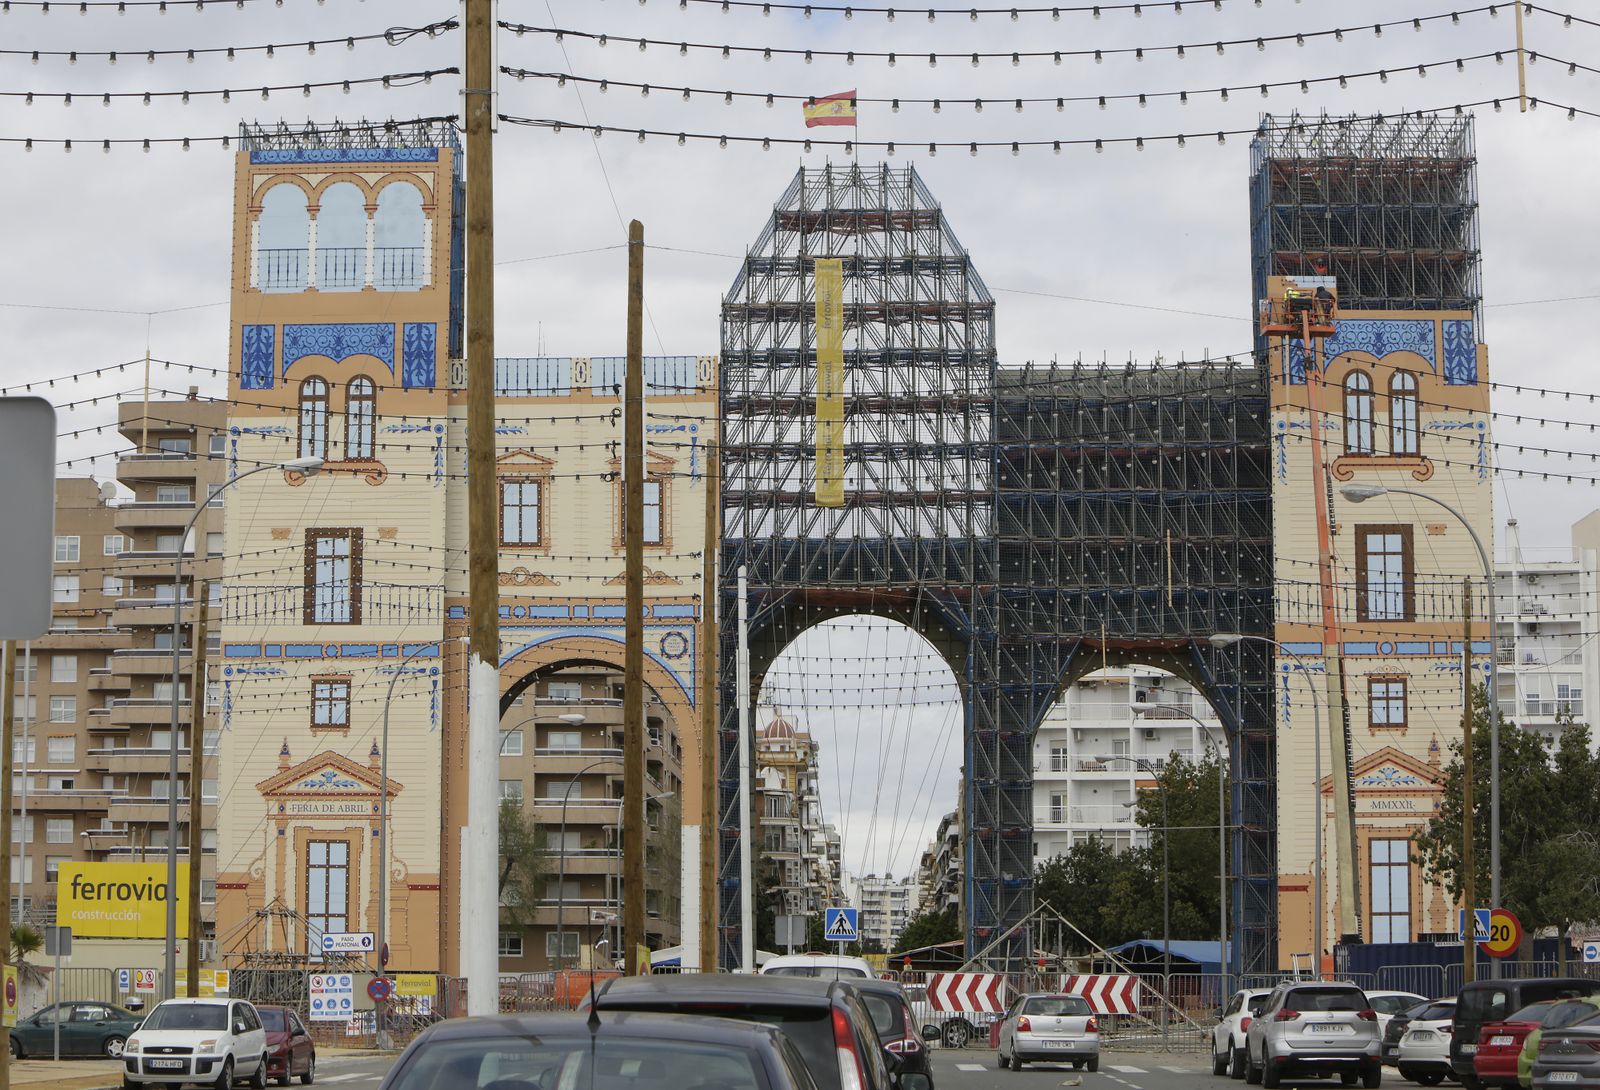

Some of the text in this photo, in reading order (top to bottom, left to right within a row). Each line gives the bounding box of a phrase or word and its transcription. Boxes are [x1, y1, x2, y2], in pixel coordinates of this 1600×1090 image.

[291, 803, 366, 813] FERIA DE ABRIL
[70, 873, 180, 902] ferrovia
[71, 909, 141, 921] construcción
[1491, 924, 1510, 942] 20
